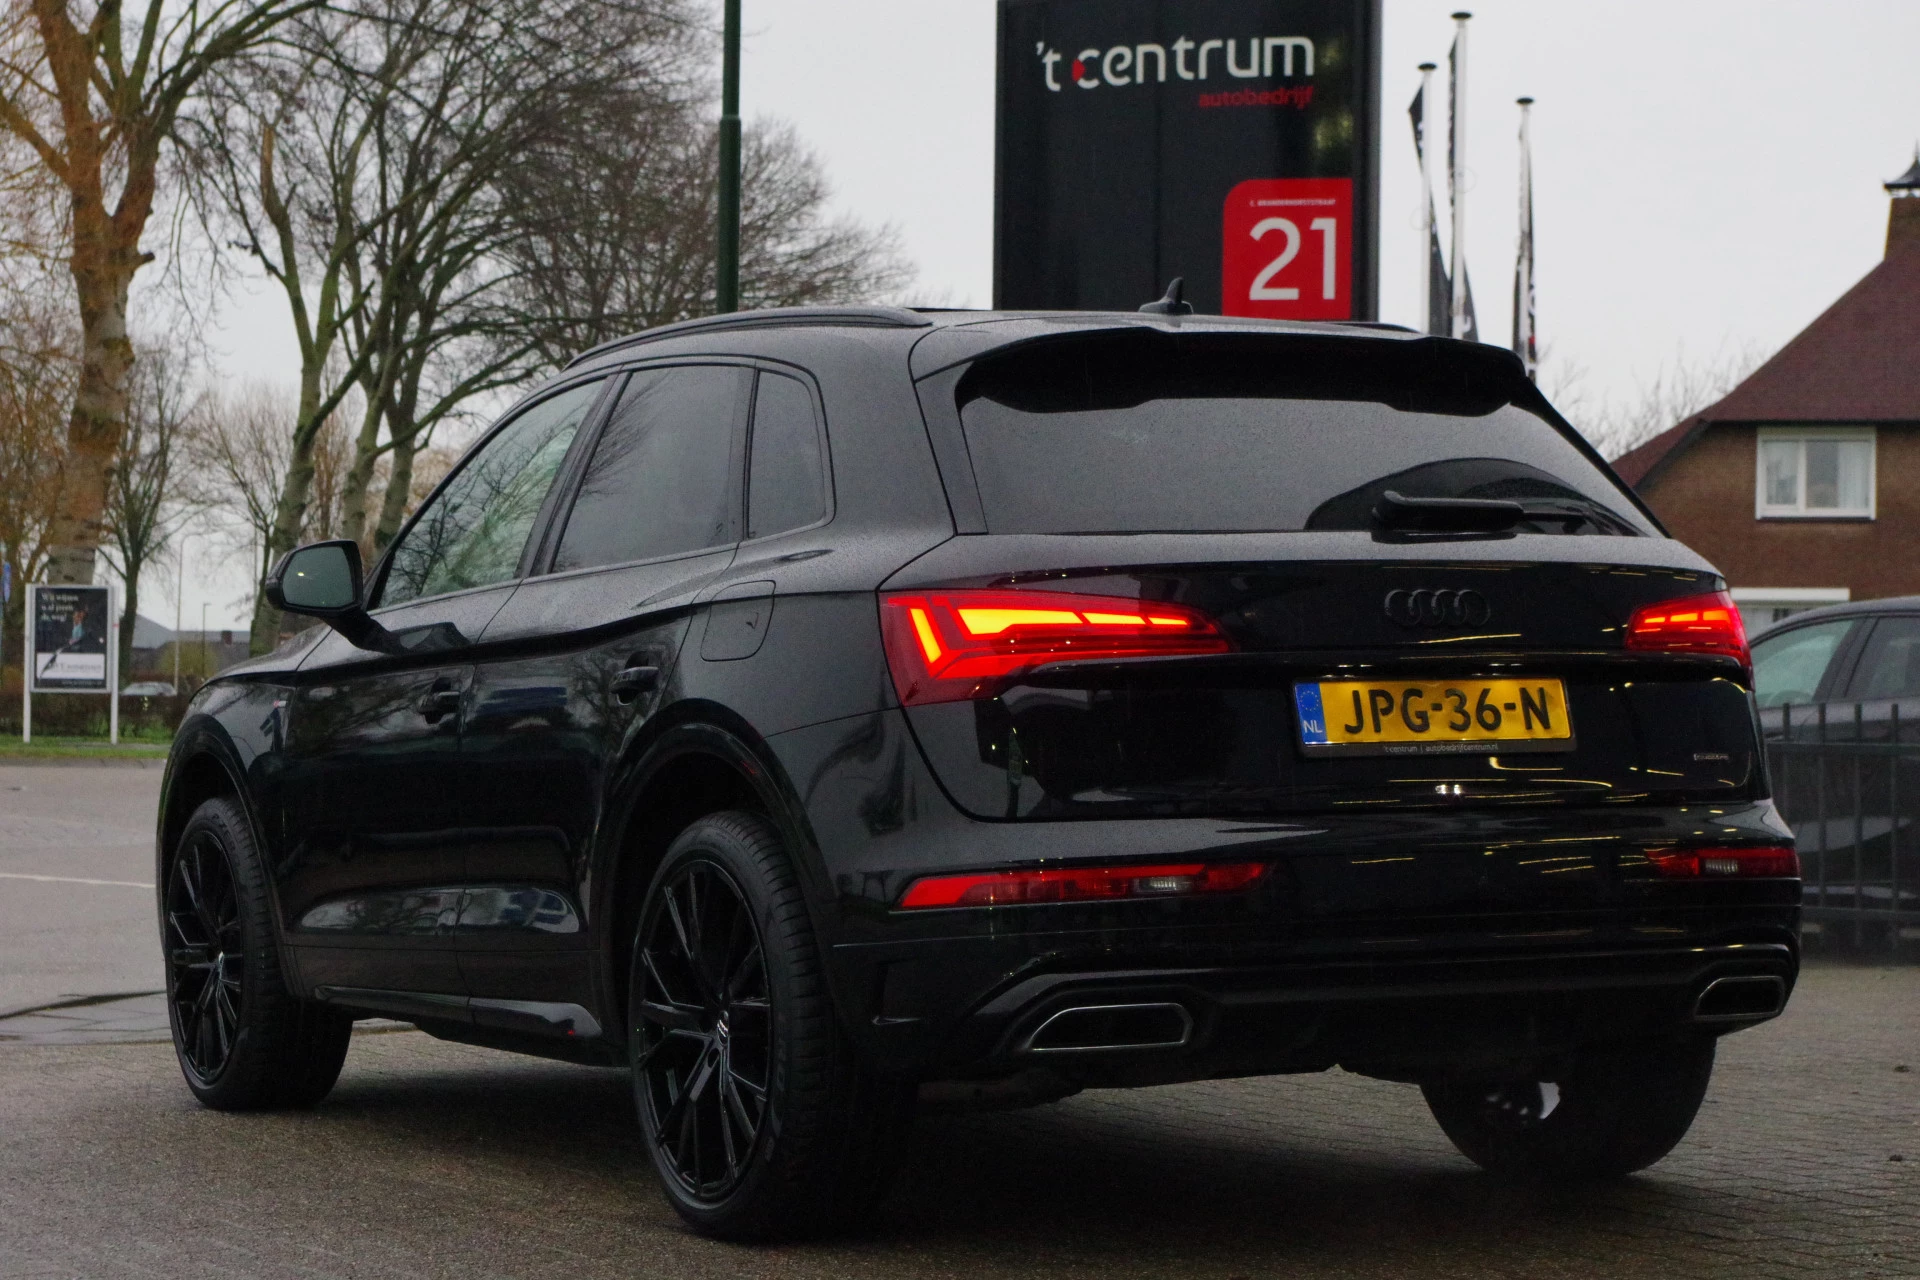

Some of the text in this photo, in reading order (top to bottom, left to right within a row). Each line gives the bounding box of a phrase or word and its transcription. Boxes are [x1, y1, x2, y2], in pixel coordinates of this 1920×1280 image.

[1072, 36, 1314, 89] centrum
[1249, 217, 1336, 300] 21
[1303, 719, 1323, 733] NL
[1344, 687, 1550, 734] JPG-36-N
